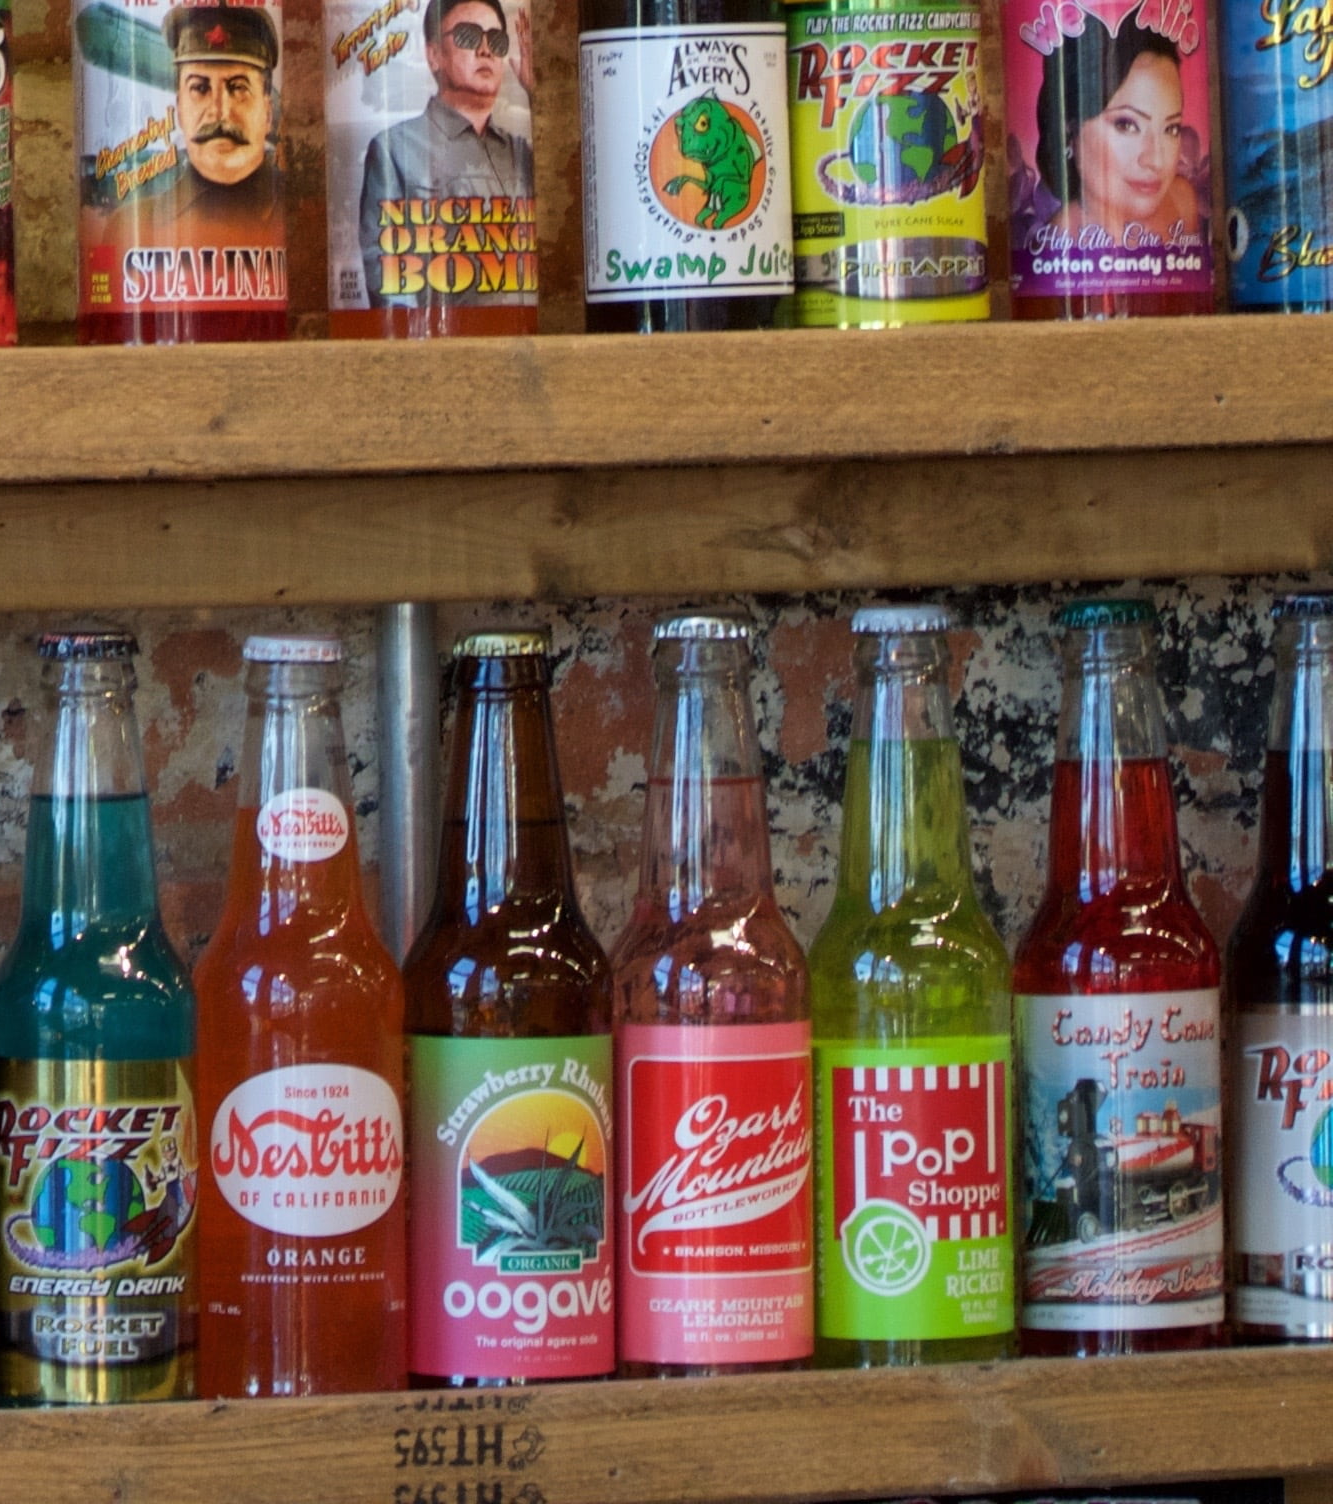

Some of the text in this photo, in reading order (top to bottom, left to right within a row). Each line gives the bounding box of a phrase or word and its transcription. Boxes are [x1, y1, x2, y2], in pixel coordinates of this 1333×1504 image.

[604, 249, 726, 284] Swamp
[1034, 252, 1202, 278] Cotton Candy Soda
[1101, 1053, 1186, 1089] Train
[284, 1085, 348, 1099] Since 1924
[848, 1095, 902, 1123] The
[216, 1109, 402, 1181] Nesbitt's
[240, 1188, 387, 1208] OF CALIFORNIA
[907, 1180, 999, 1210] Shoppe
[266, 1247, 367, 1266] ORANGE
[956, 1250, 999, 1270] LIME
[946, 1272, 1004, 1297] RICKEY
